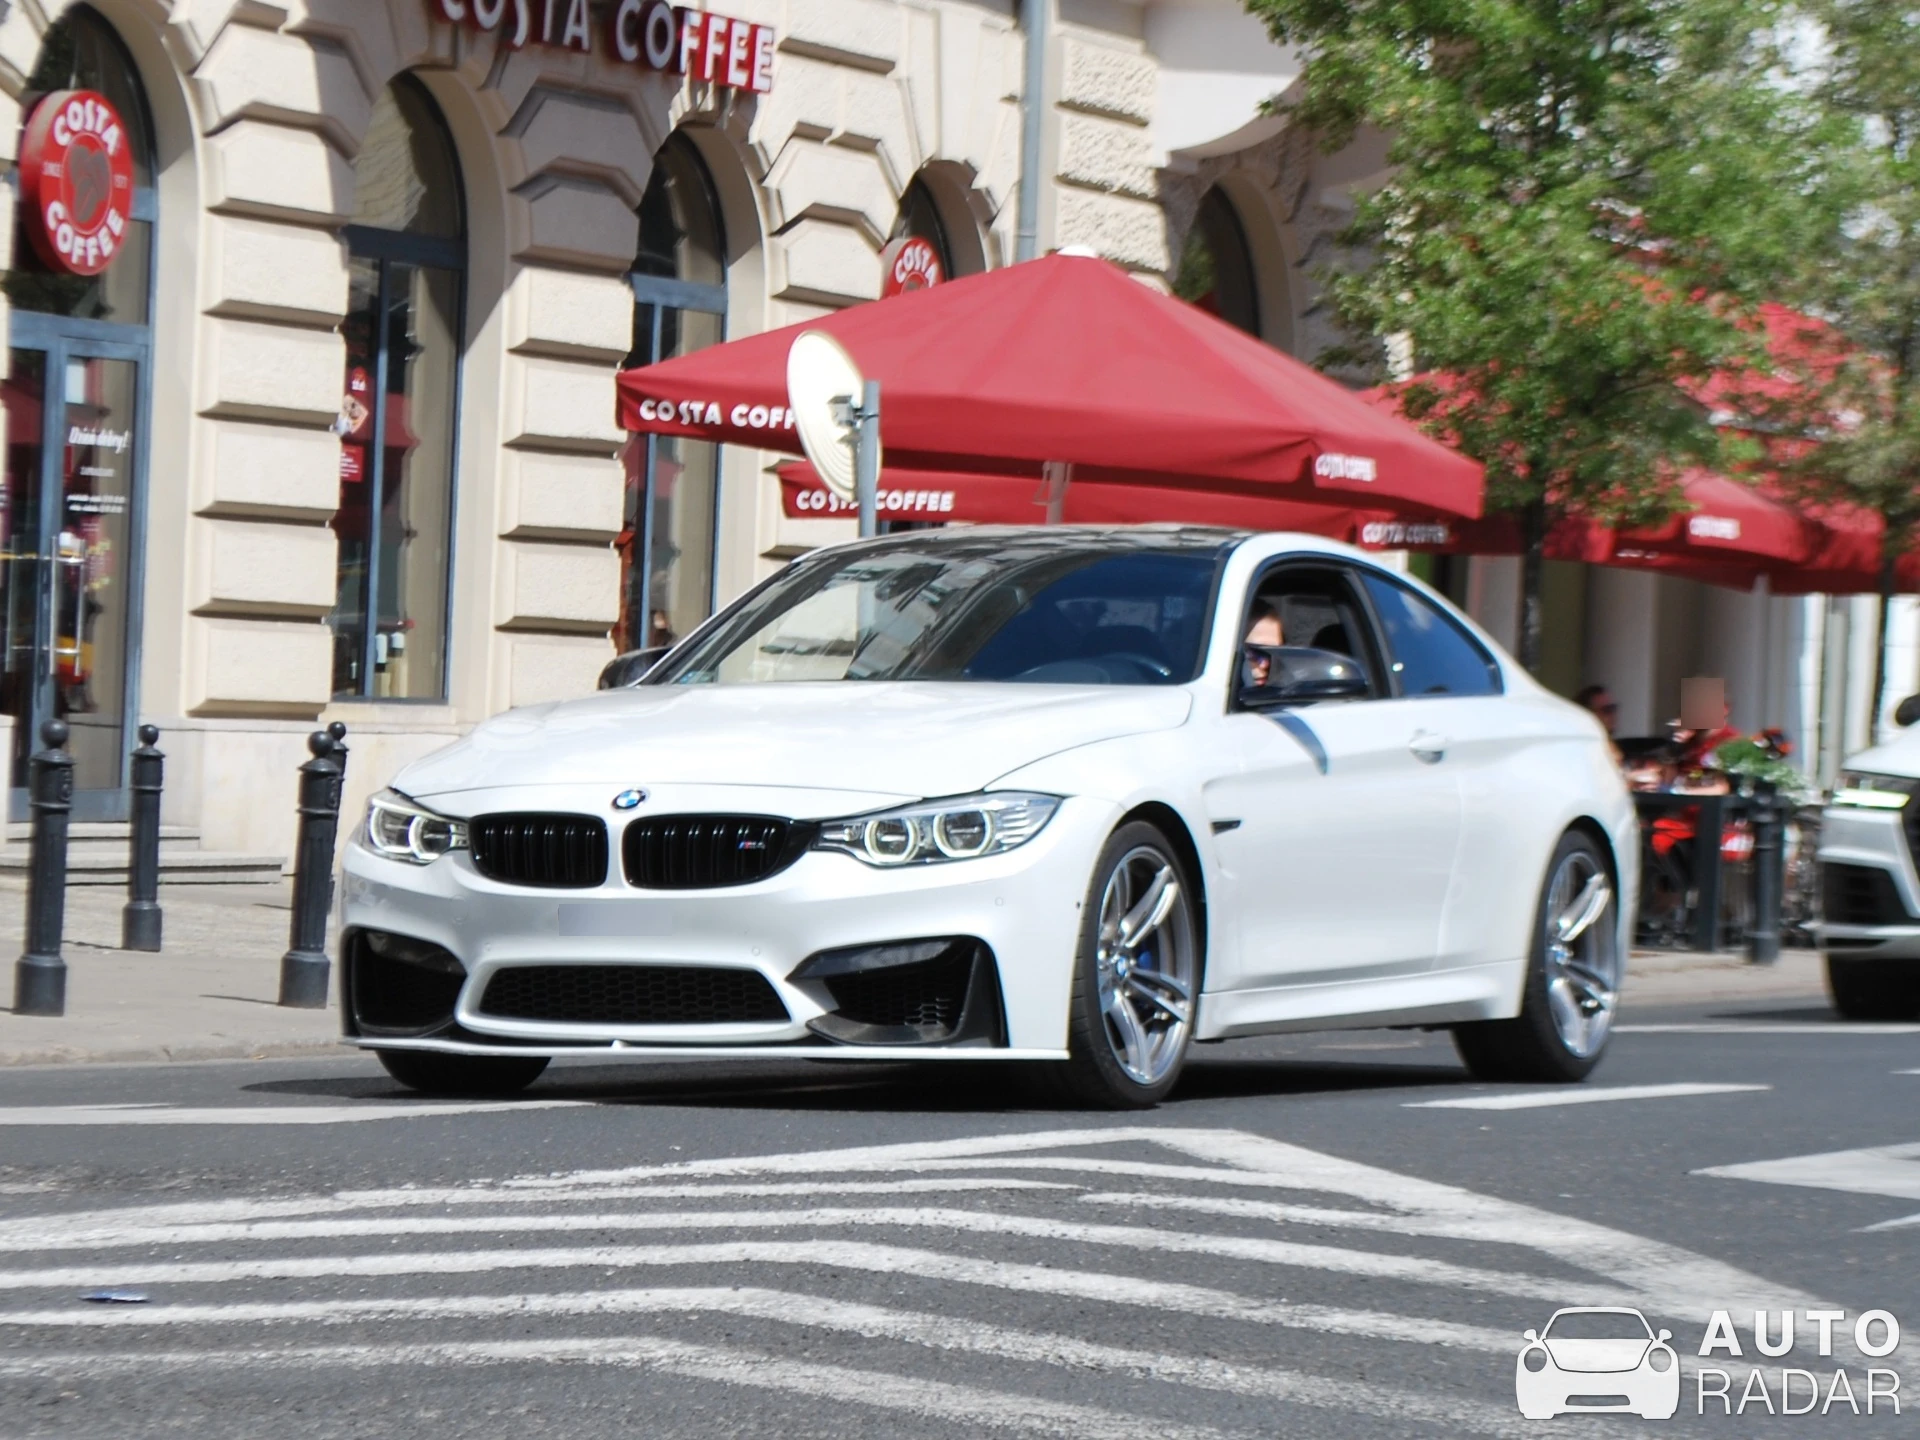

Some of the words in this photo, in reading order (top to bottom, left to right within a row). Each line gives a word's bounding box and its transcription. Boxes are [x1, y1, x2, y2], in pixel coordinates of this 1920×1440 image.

[616, 0, 773, 93] COFFEE
[53, 99, 120, 155] COSTA
[47, 200, 124, 267] COFFEE
[895, 242, 938, 288] COSTA
[639, 399, 723, 426] COSTA
[730, 403, 797, 430] COFF
[875, 490, 955, 512] COFFEE
